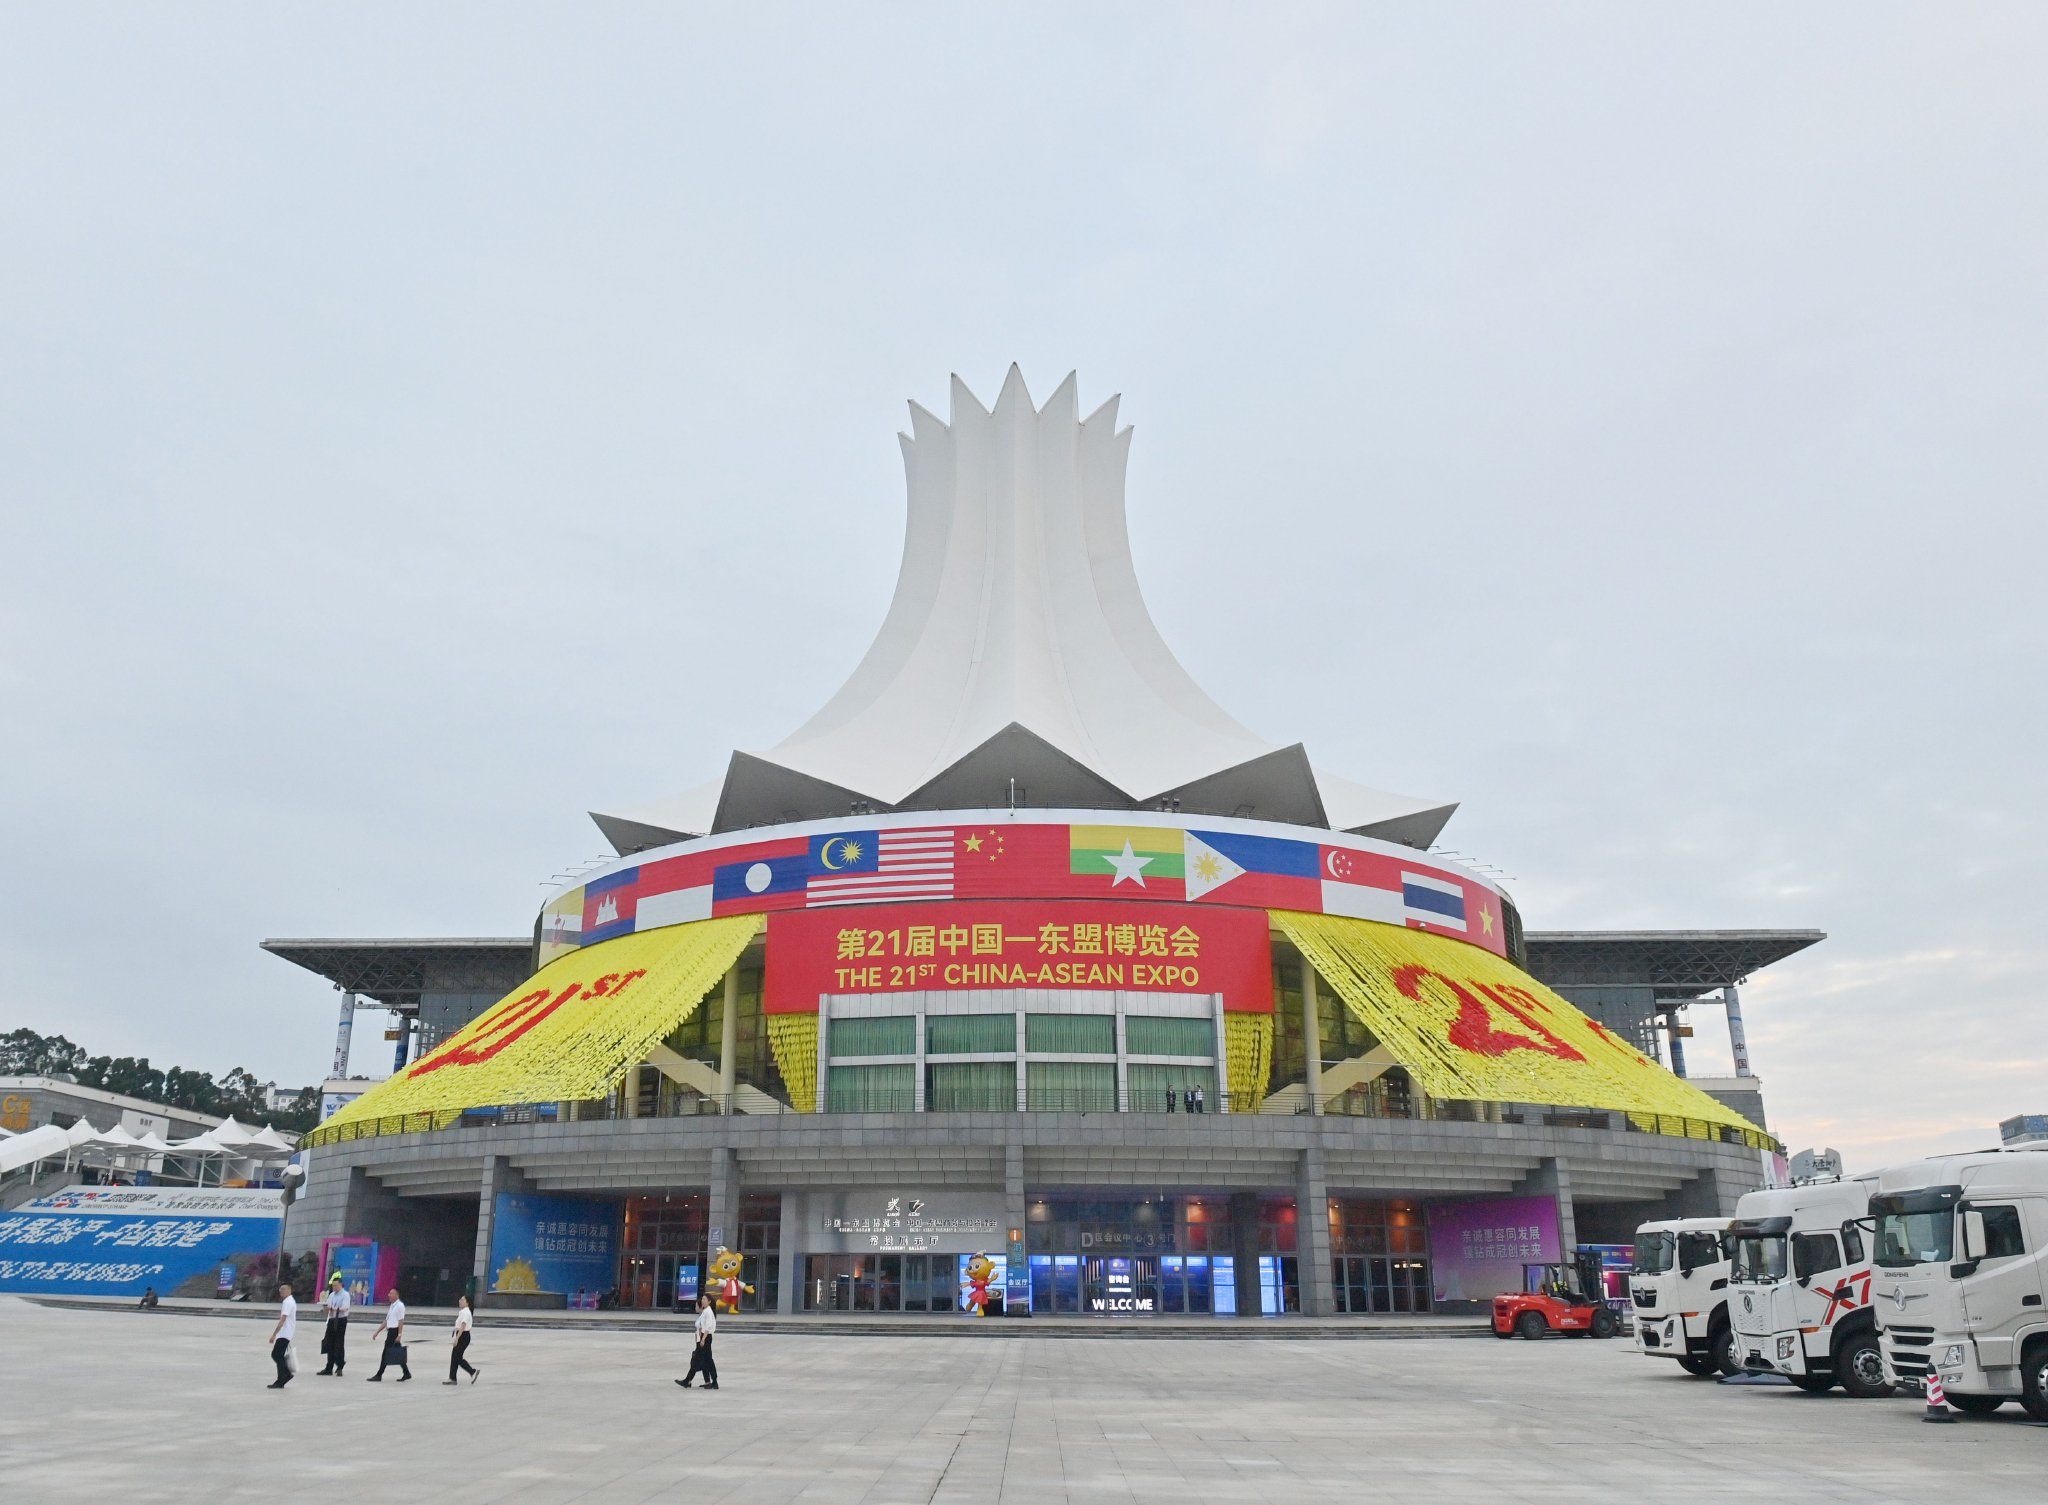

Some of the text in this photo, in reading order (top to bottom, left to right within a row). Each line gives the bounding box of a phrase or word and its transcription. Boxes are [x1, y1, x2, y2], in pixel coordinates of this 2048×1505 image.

[835, 922, 1200, 960] 第21届中国—东盟博览会
[834, 963, 1199, 988] THE 21ST CHINA-ASEAN EXPO
[536, 1221, 609, 1238] 亲诚惠容同发展
[1462, 1226, 1541, 1243] 亲诚惠容同发展
[1007, 1279, 1028, 1287] 会议厅
